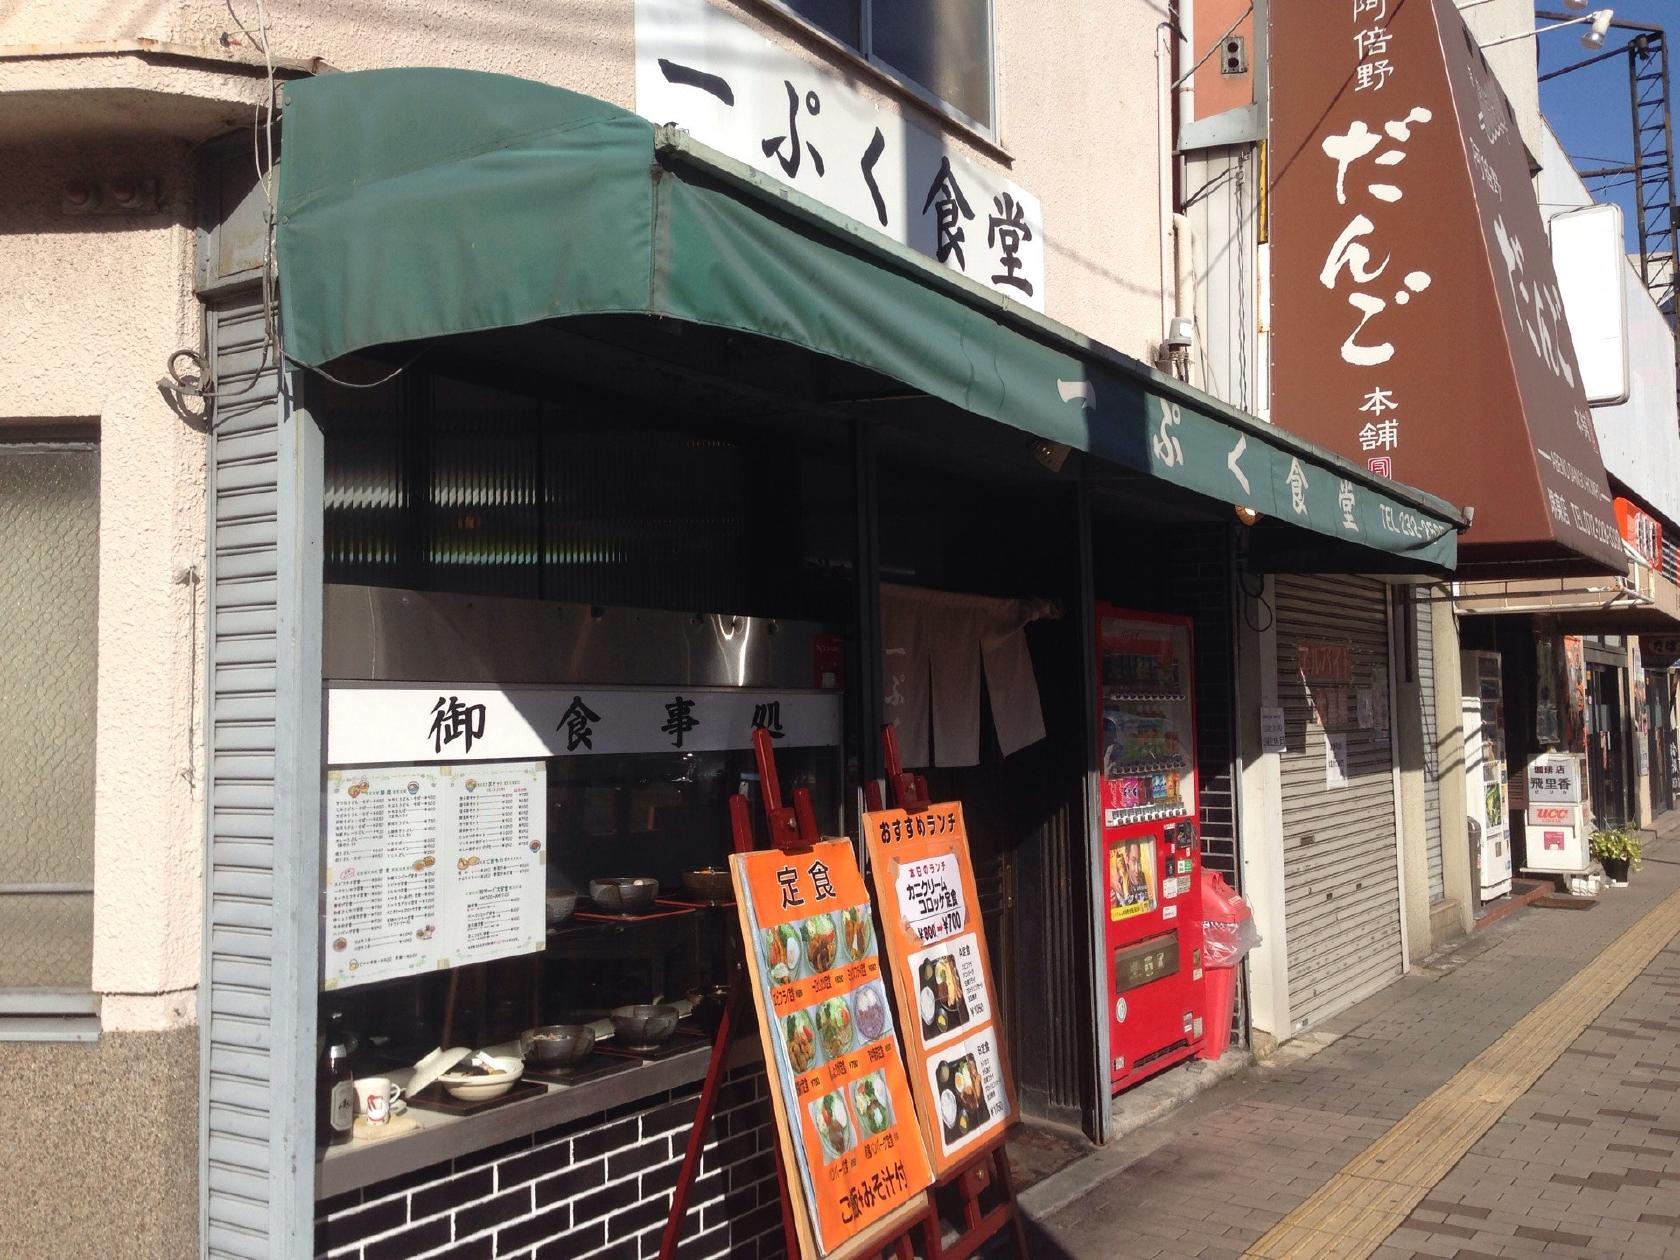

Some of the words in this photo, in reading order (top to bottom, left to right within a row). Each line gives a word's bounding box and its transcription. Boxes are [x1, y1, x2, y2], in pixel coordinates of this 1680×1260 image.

[657, 58, 1034, 297] 一ぷく食堂
[1320, 106, 1432, 367] だんご
[1358, 386, 1400, 451] 本舗
[1056, 378, 1360, 533] 一ぷく食堂
[1379, 503, 1401, 533] TEL
[426, 695, 786, 755] 御食事処
[1530, 777, 1571, 790] 飛里香
[879, 812, 957, 844] おすすめランチ
[1536, 808, 1568, 819] UCC
[776, 860, 838, 910] 定食
[908, 861, 947, 879] 本日のランチ
[906, 876, 948, 901] カニクリーム
[917, 889, 959, 915] コロッケ定食
[941, 911, 962, 935] ¥700
